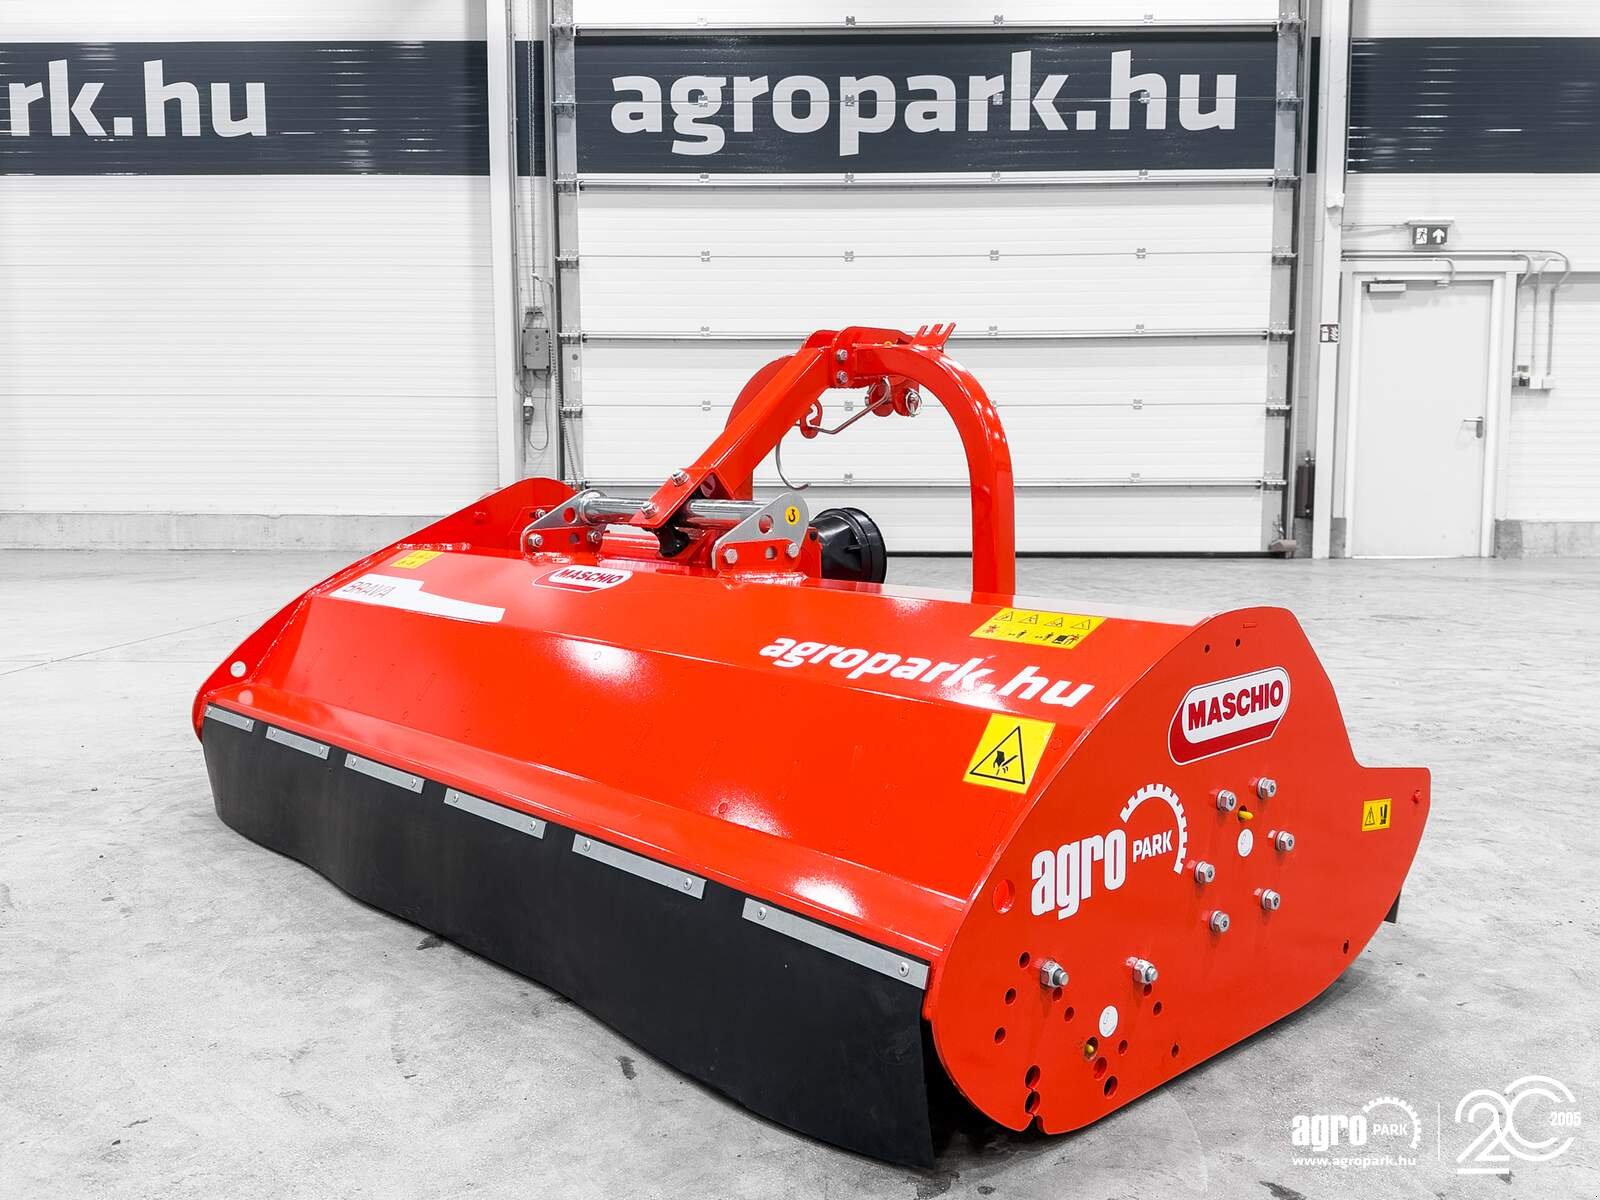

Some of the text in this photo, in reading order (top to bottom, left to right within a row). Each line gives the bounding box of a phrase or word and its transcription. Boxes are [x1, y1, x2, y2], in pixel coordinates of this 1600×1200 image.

[611, 50, 1238, 156] agropark.hu
[556, 568, 624, 584] MASCHIO
[759, 637, 1095, 707] agropark.hu
[1188, 680, 1284, 731] MASCHIO
[1031, 829, 1174, 920] agro PARK
